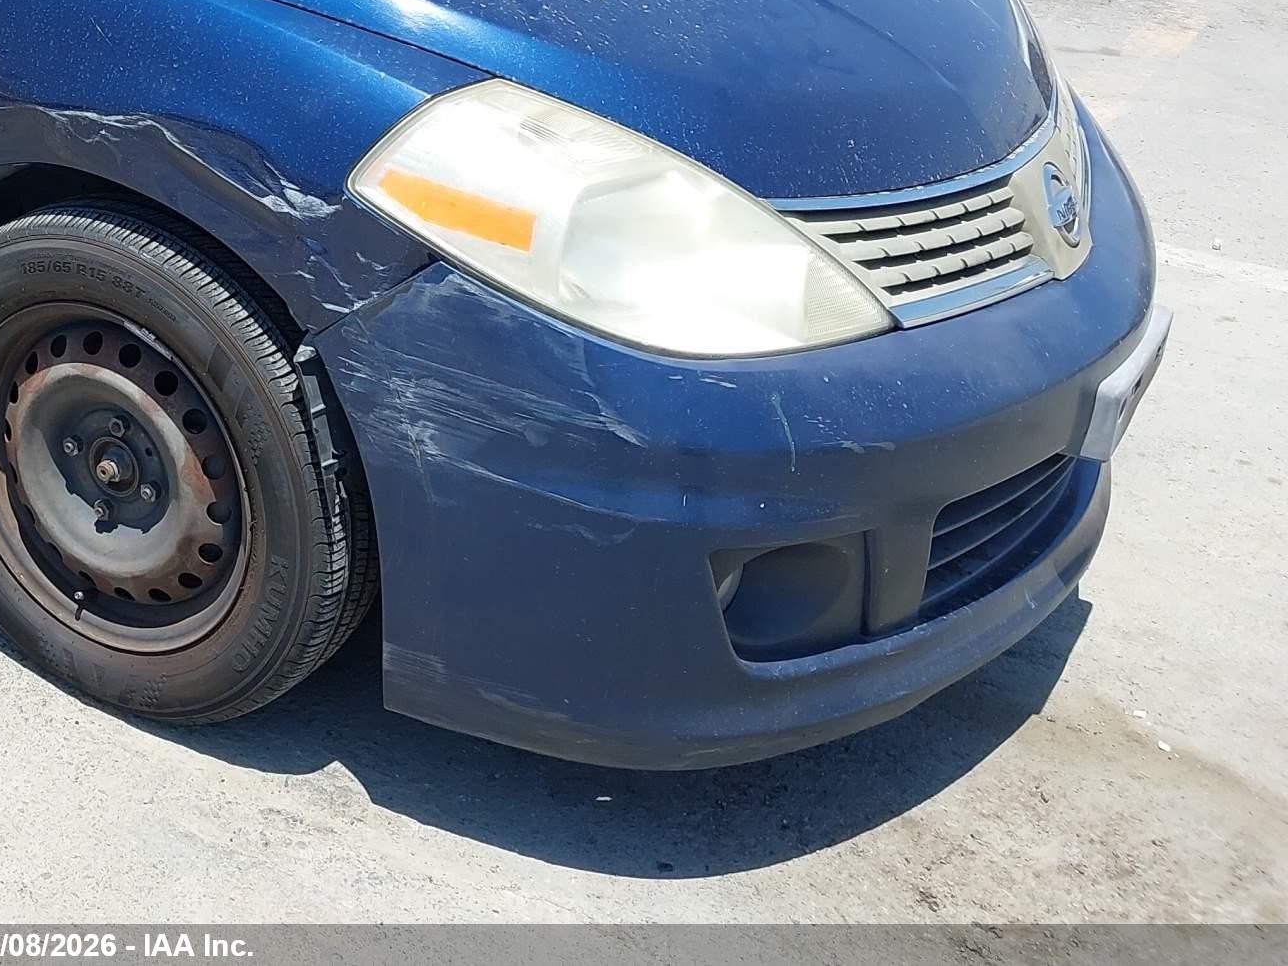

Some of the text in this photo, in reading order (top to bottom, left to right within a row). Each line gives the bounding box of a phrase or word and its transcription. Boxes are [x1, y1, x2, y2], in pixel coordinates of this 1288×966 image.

[20, 259, 148, 299] 185/65 R15 88T
[233, 553, 289, 674] KUMHO
